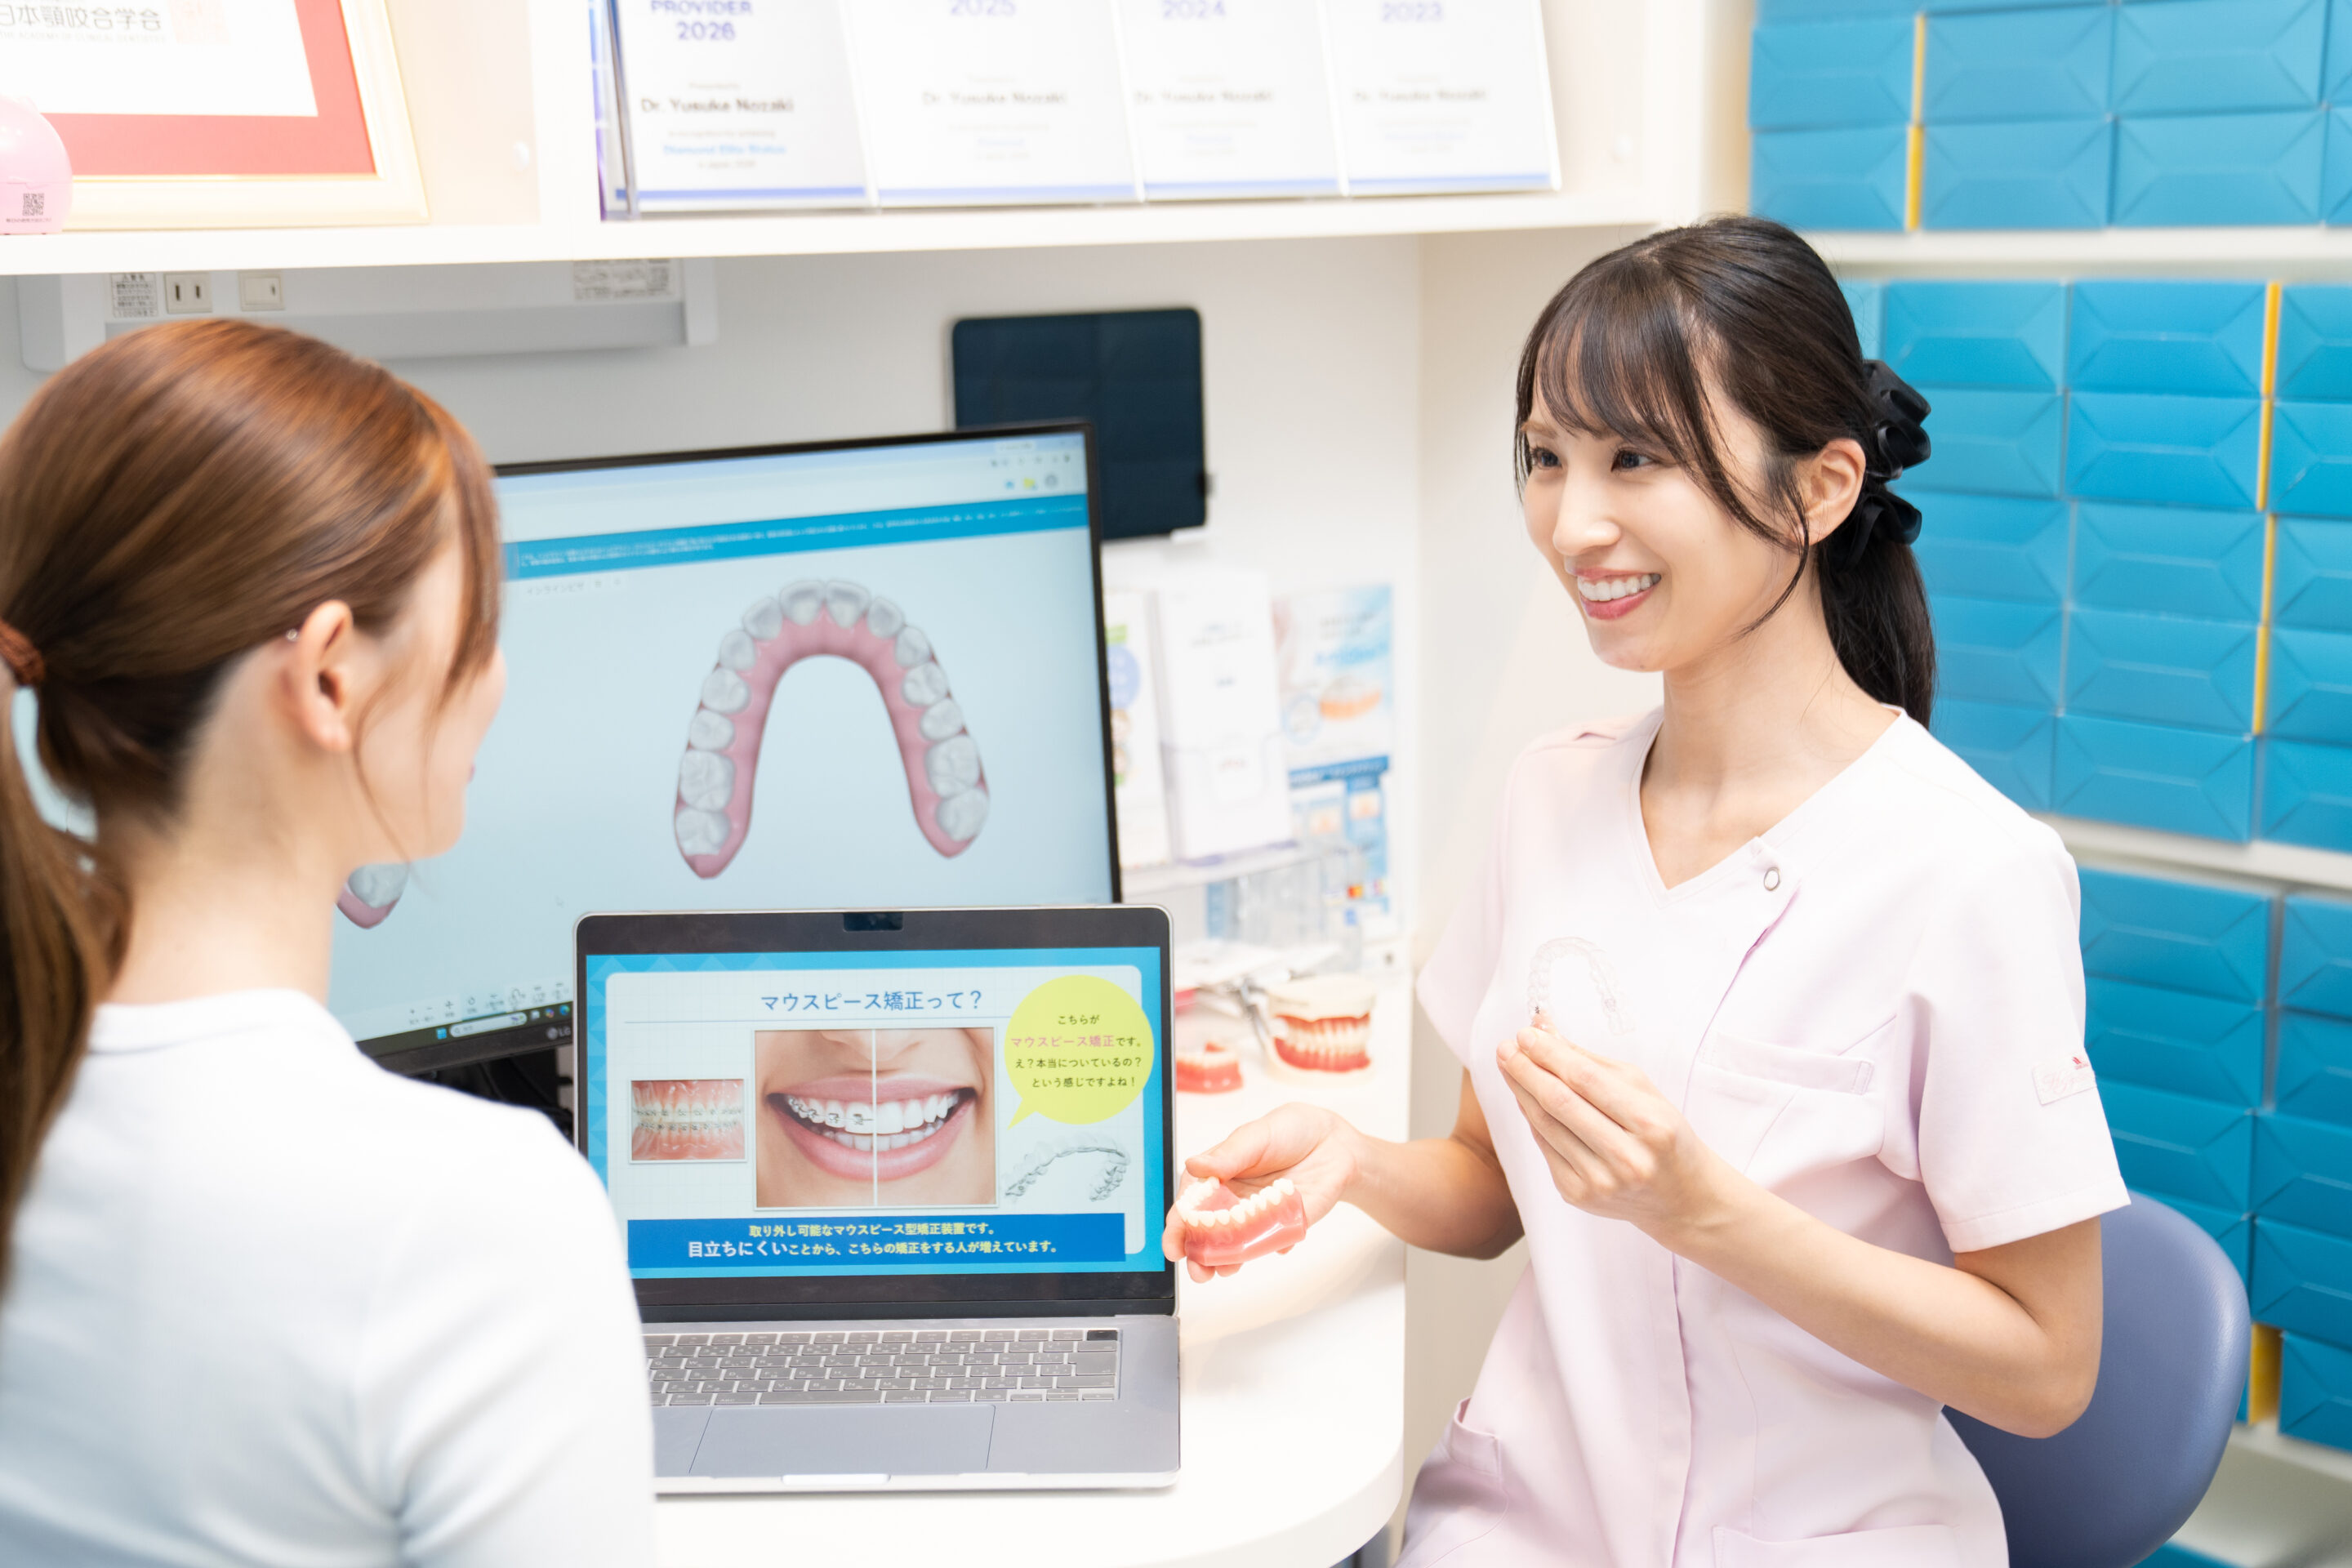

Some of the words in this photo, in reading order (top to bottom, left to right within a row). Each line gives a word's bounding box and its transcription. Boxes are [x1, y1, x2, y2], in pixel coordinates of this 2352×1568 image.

[650, 0, 753, 15] PROVIDER
[1161, 0, 1227, 20] 2024
[1381, 2, 1446, 23] 2023
[676, 21, 736, 41] 2026
[640, 98, 663, 112] Dr.
[670, 98, 731, 113] Yusuke
[736, 98, 794, 113] Nozaki
[761, 991, 982, 1011] マウスピース矯正って？
[1058, 1014, 1100, 1025] こちらが
[559, 1026, 572, 1036] LG
[1011, 1035, 1141, 1047] マウスピース矯正です。
[1015, 1057, 1142, 1069] え？本当についているの？
[1032, 1076, 1135, 1088] という感じですよね！
[749, 1223, 995, 1238] 取り外し可能なマウスピース型矯正装置です。
[688, 1239, 1058, 1258] 目立ちにくいことから、こちらの矯正をする人が増えています。
